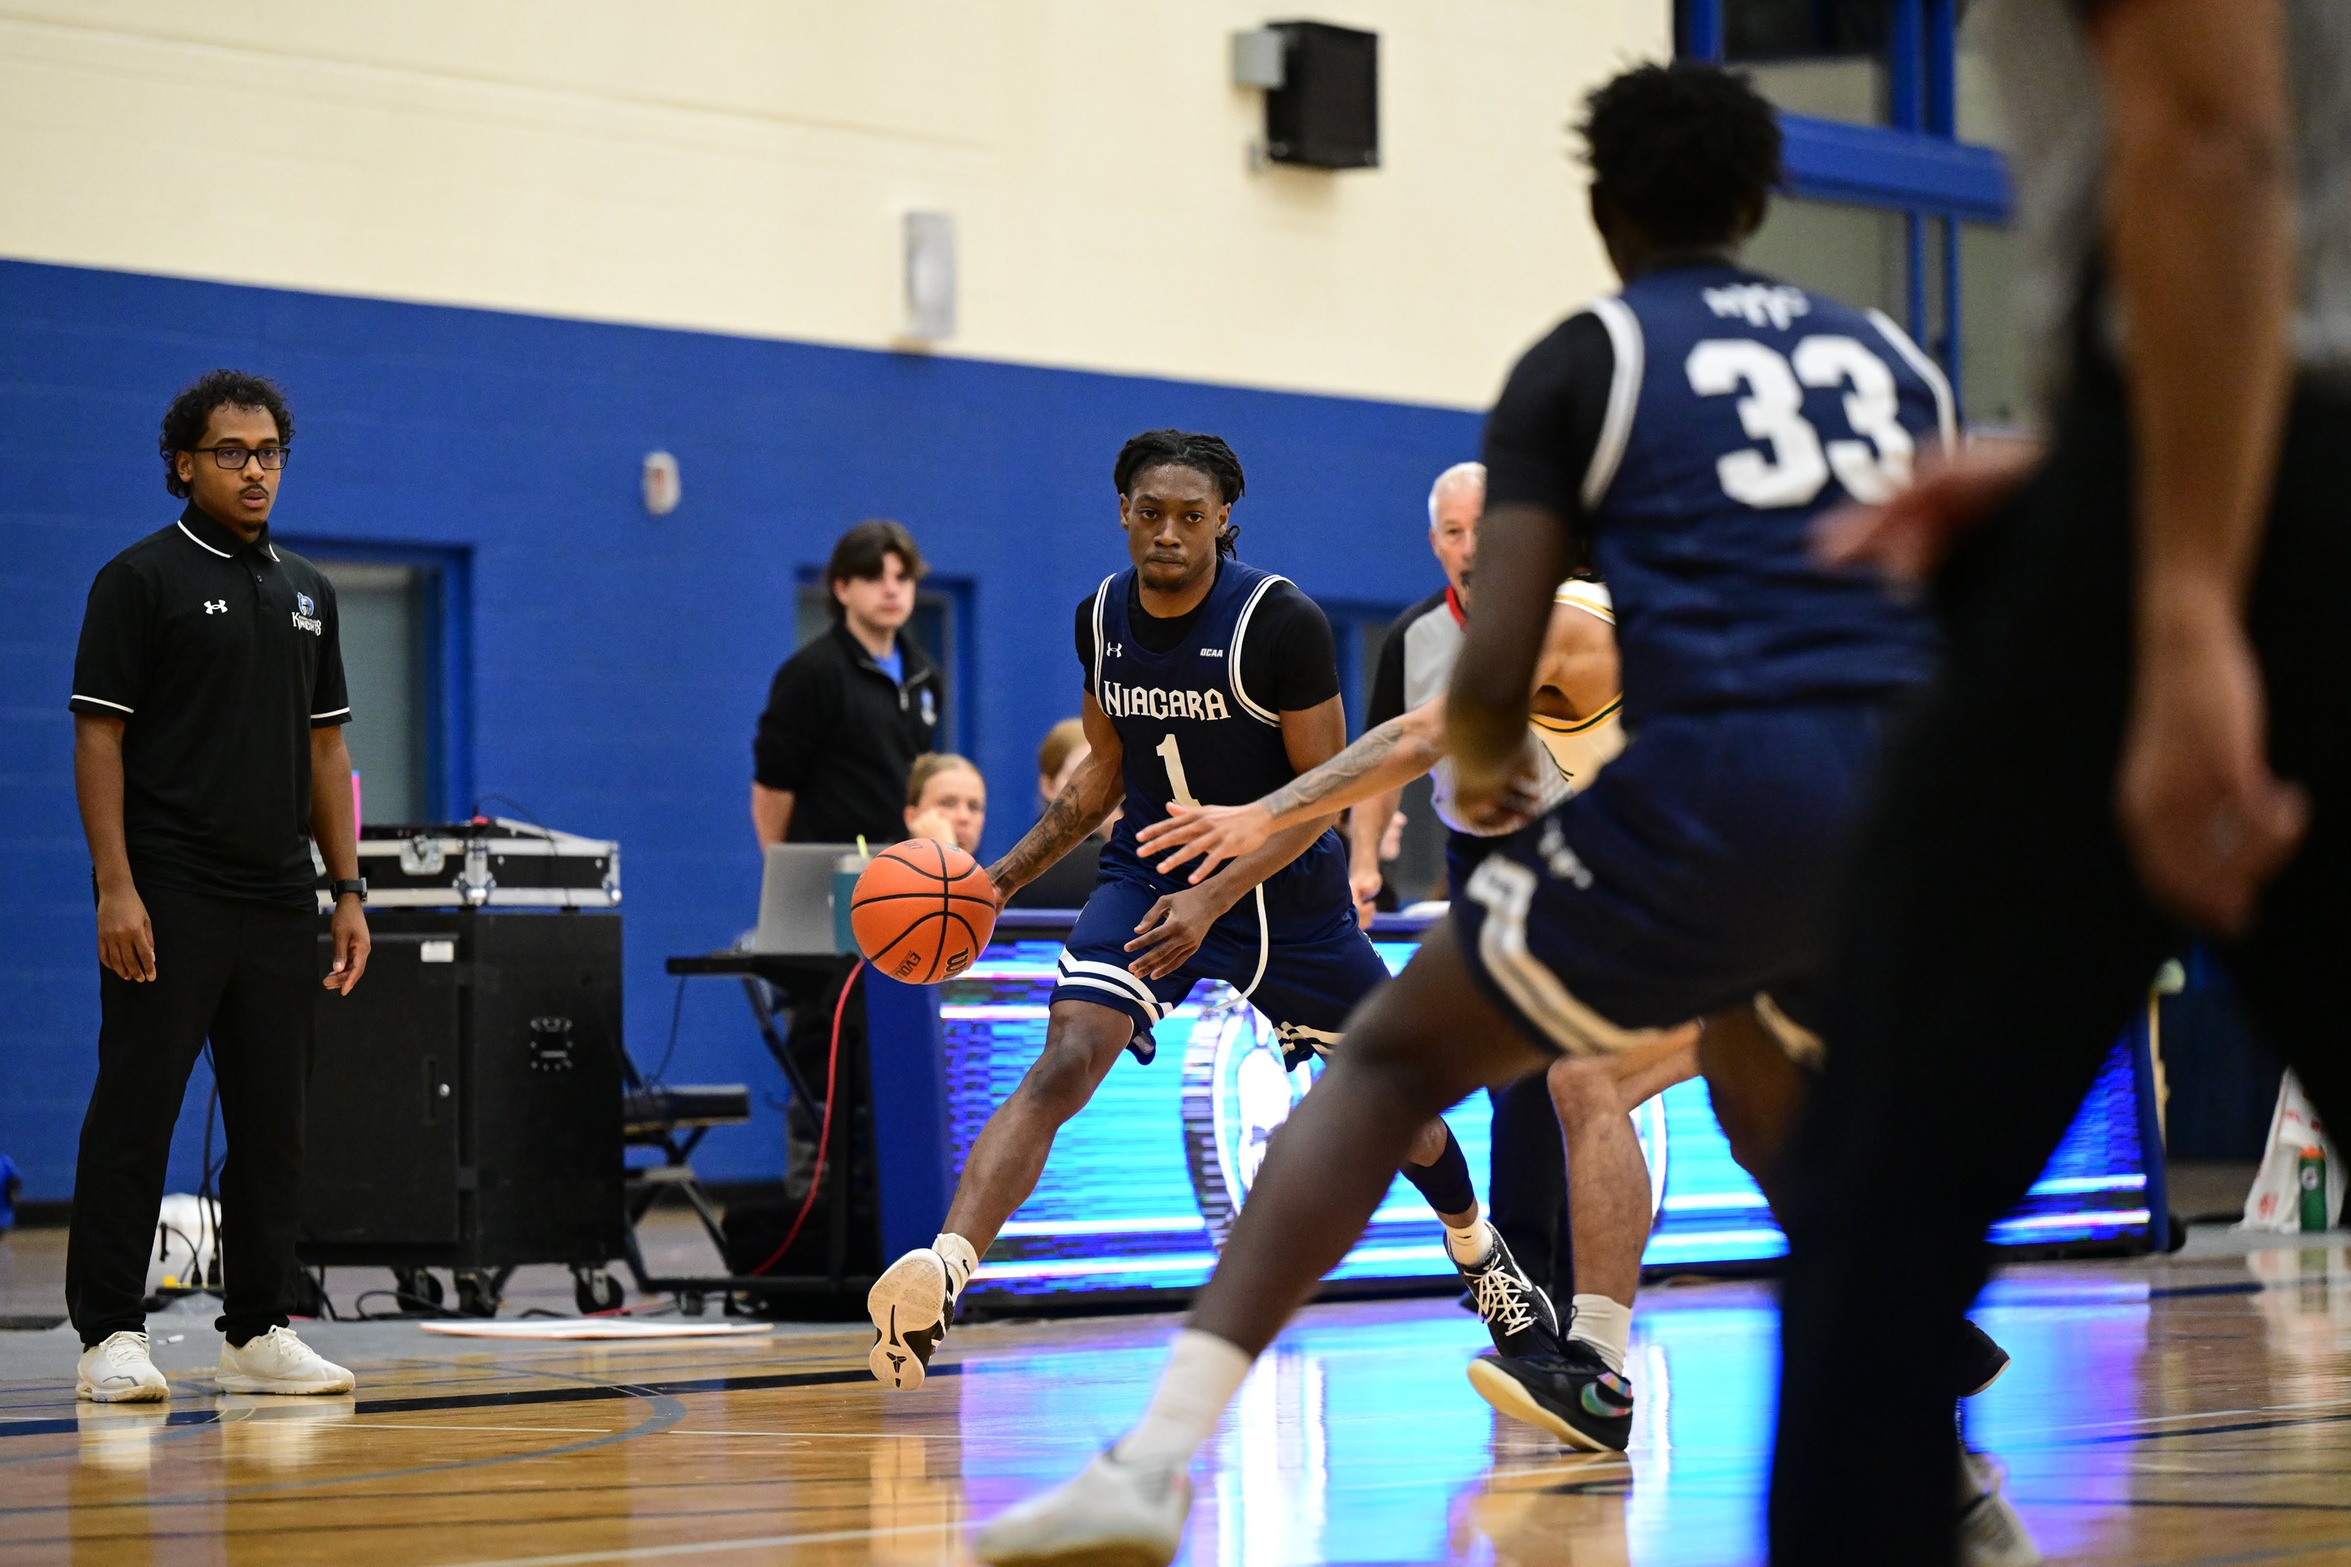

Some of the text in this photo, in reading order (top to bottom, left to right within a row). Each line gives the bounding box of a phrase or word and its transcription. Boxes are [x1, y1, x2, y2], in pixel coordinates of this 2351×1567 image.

[1685, 335, 1915, 508] 33
[1103, 680, 1232, 721] NIAGARA
[1155, 733, 1202, 808] 1
